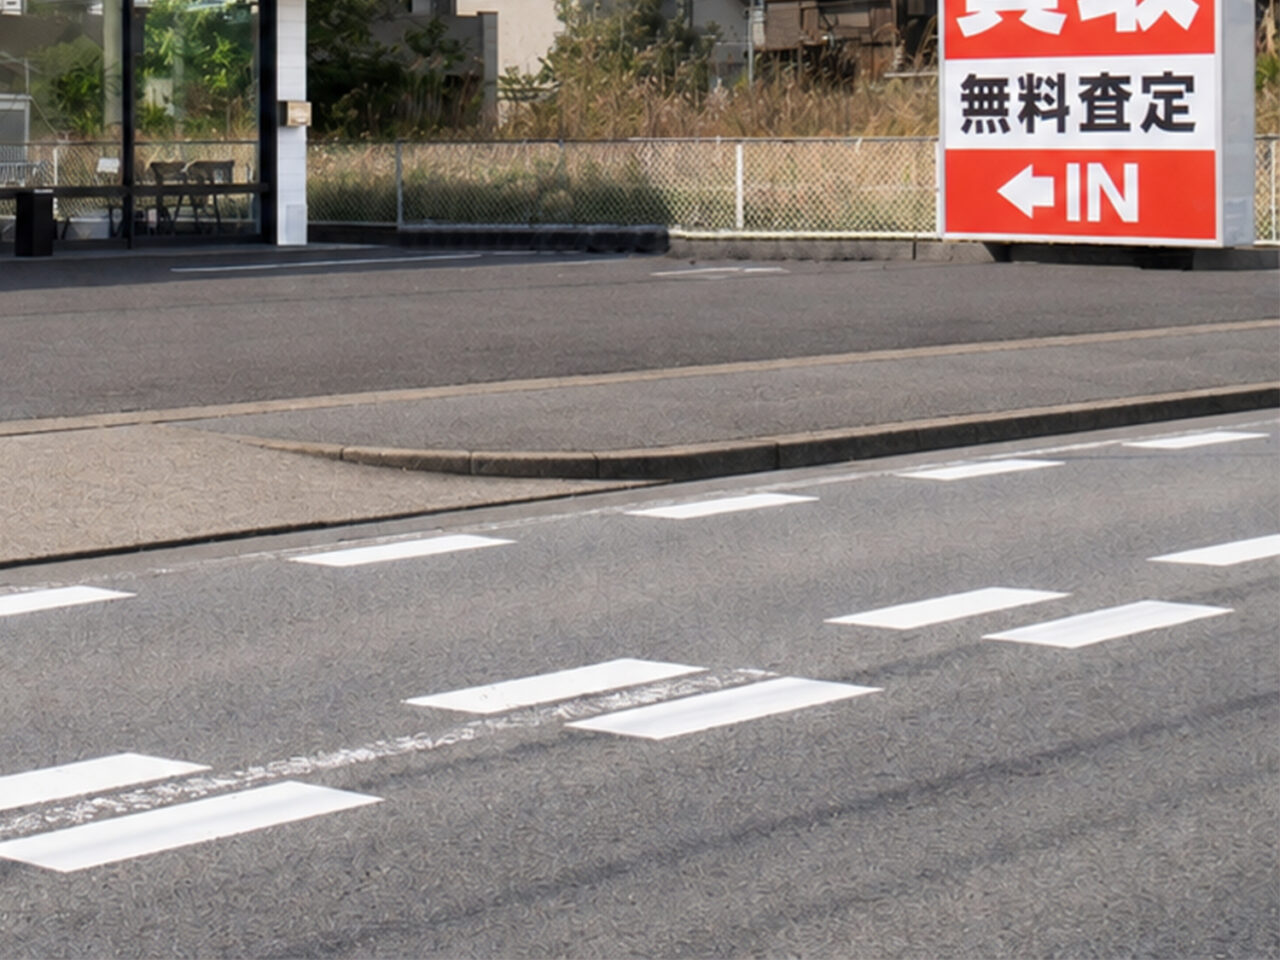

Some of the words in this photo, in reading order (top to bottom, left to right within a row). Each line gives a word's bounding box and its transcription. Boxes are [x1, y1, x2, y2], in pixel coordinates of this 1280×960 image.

[960, 71, 1197, 134] 無料査定
[1066, 163, 1139, 223] IN
